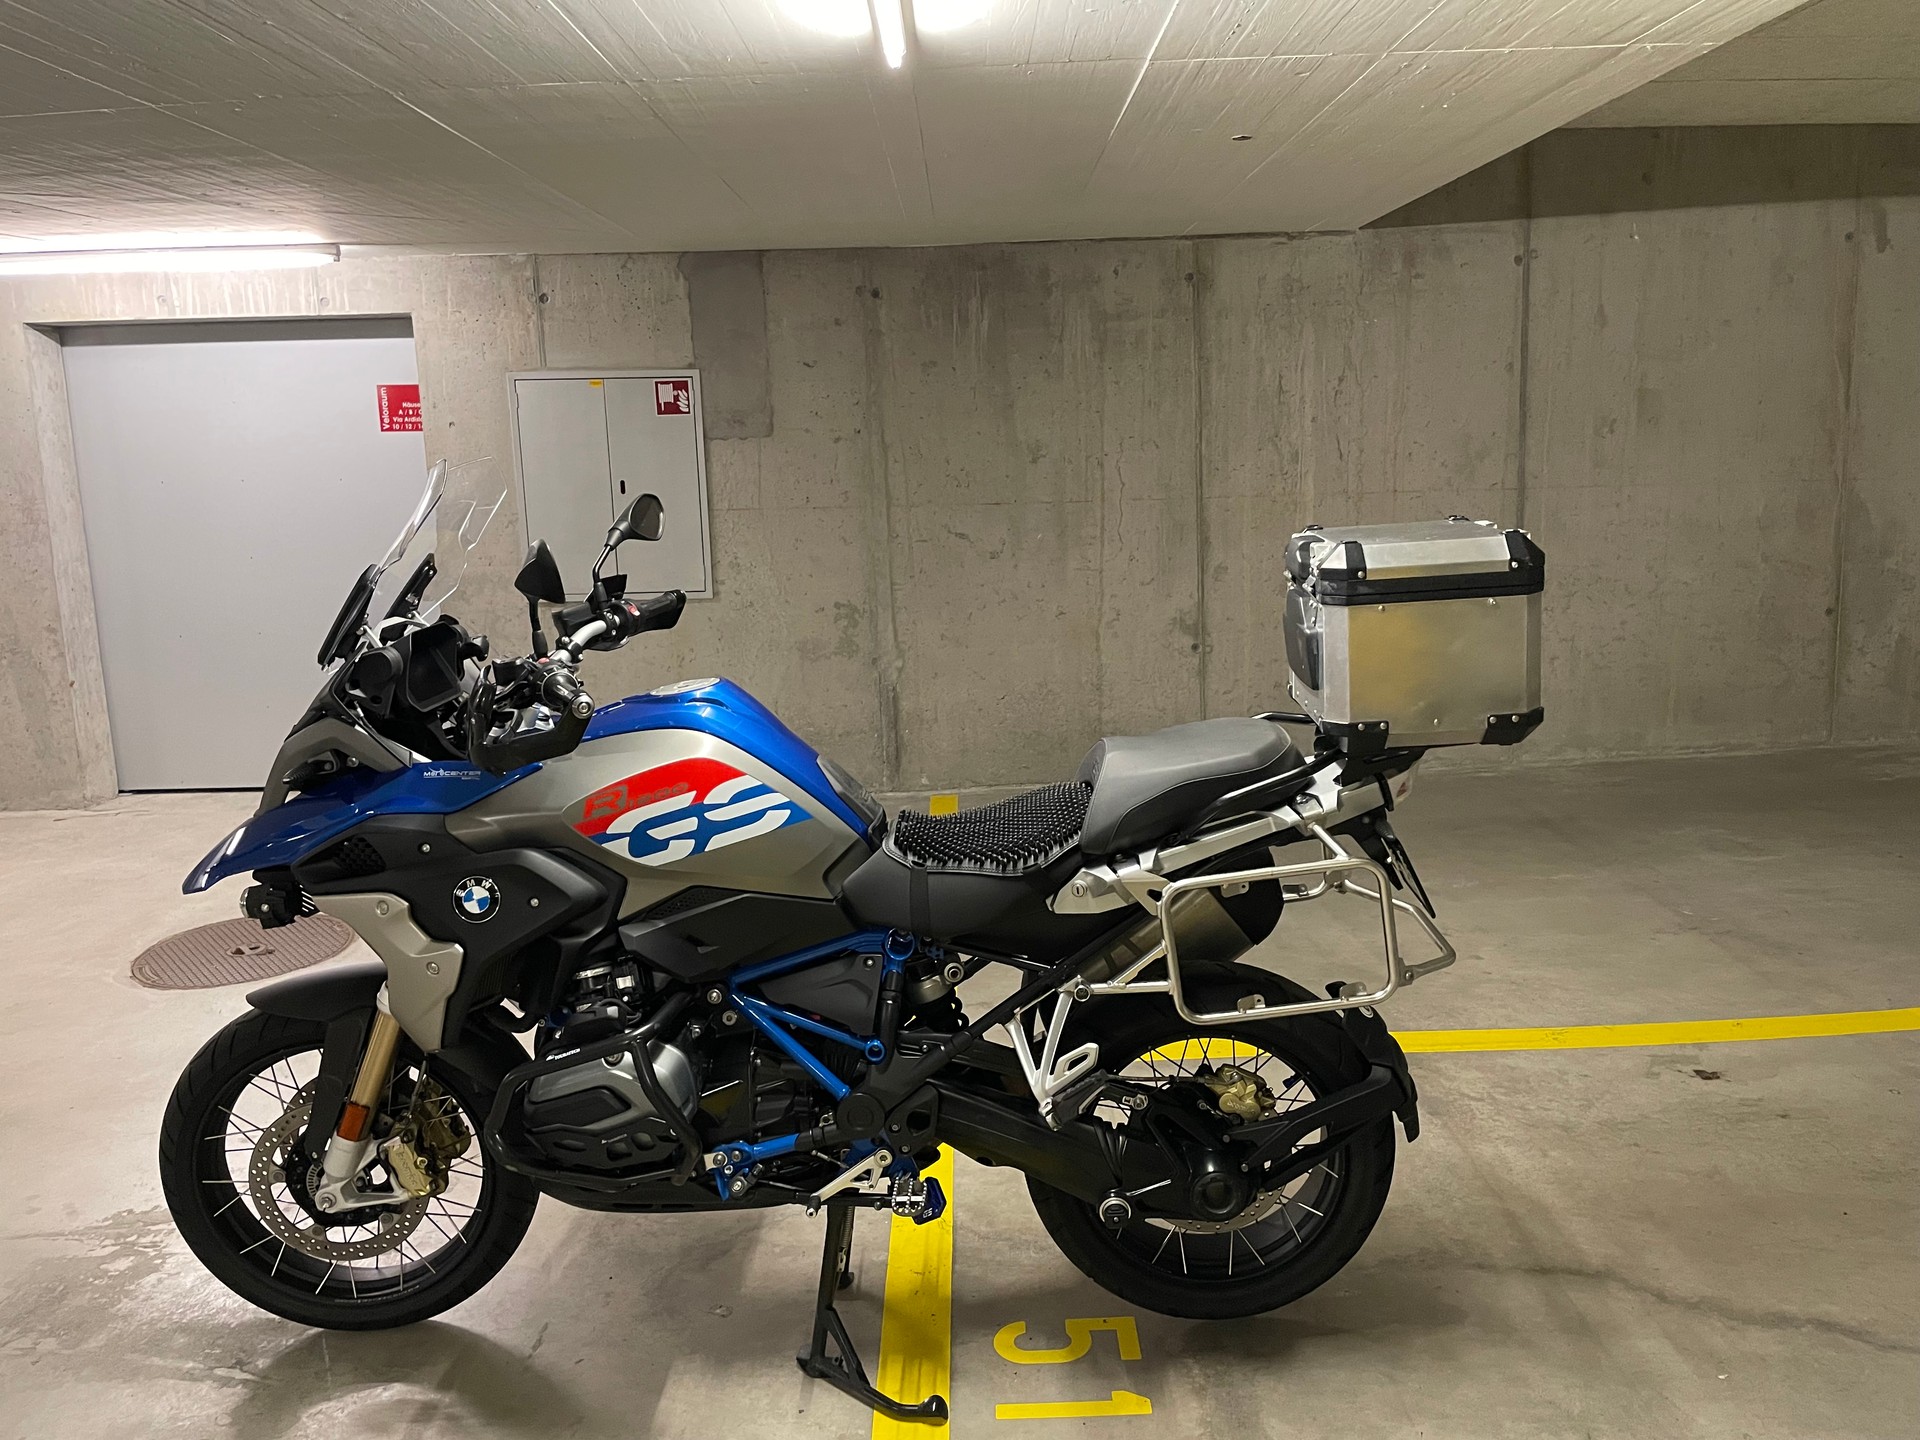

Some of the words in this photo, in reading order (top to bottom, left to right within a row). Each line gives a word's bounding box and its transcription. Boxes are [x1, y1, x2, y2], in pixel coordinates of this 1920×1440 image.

[380, 387, 390, 430] Veloraum
[601, 774, 791, 867] GS
[456, 878, 492, 898] BMW
[993, 1316, 1152, 1420] 51
